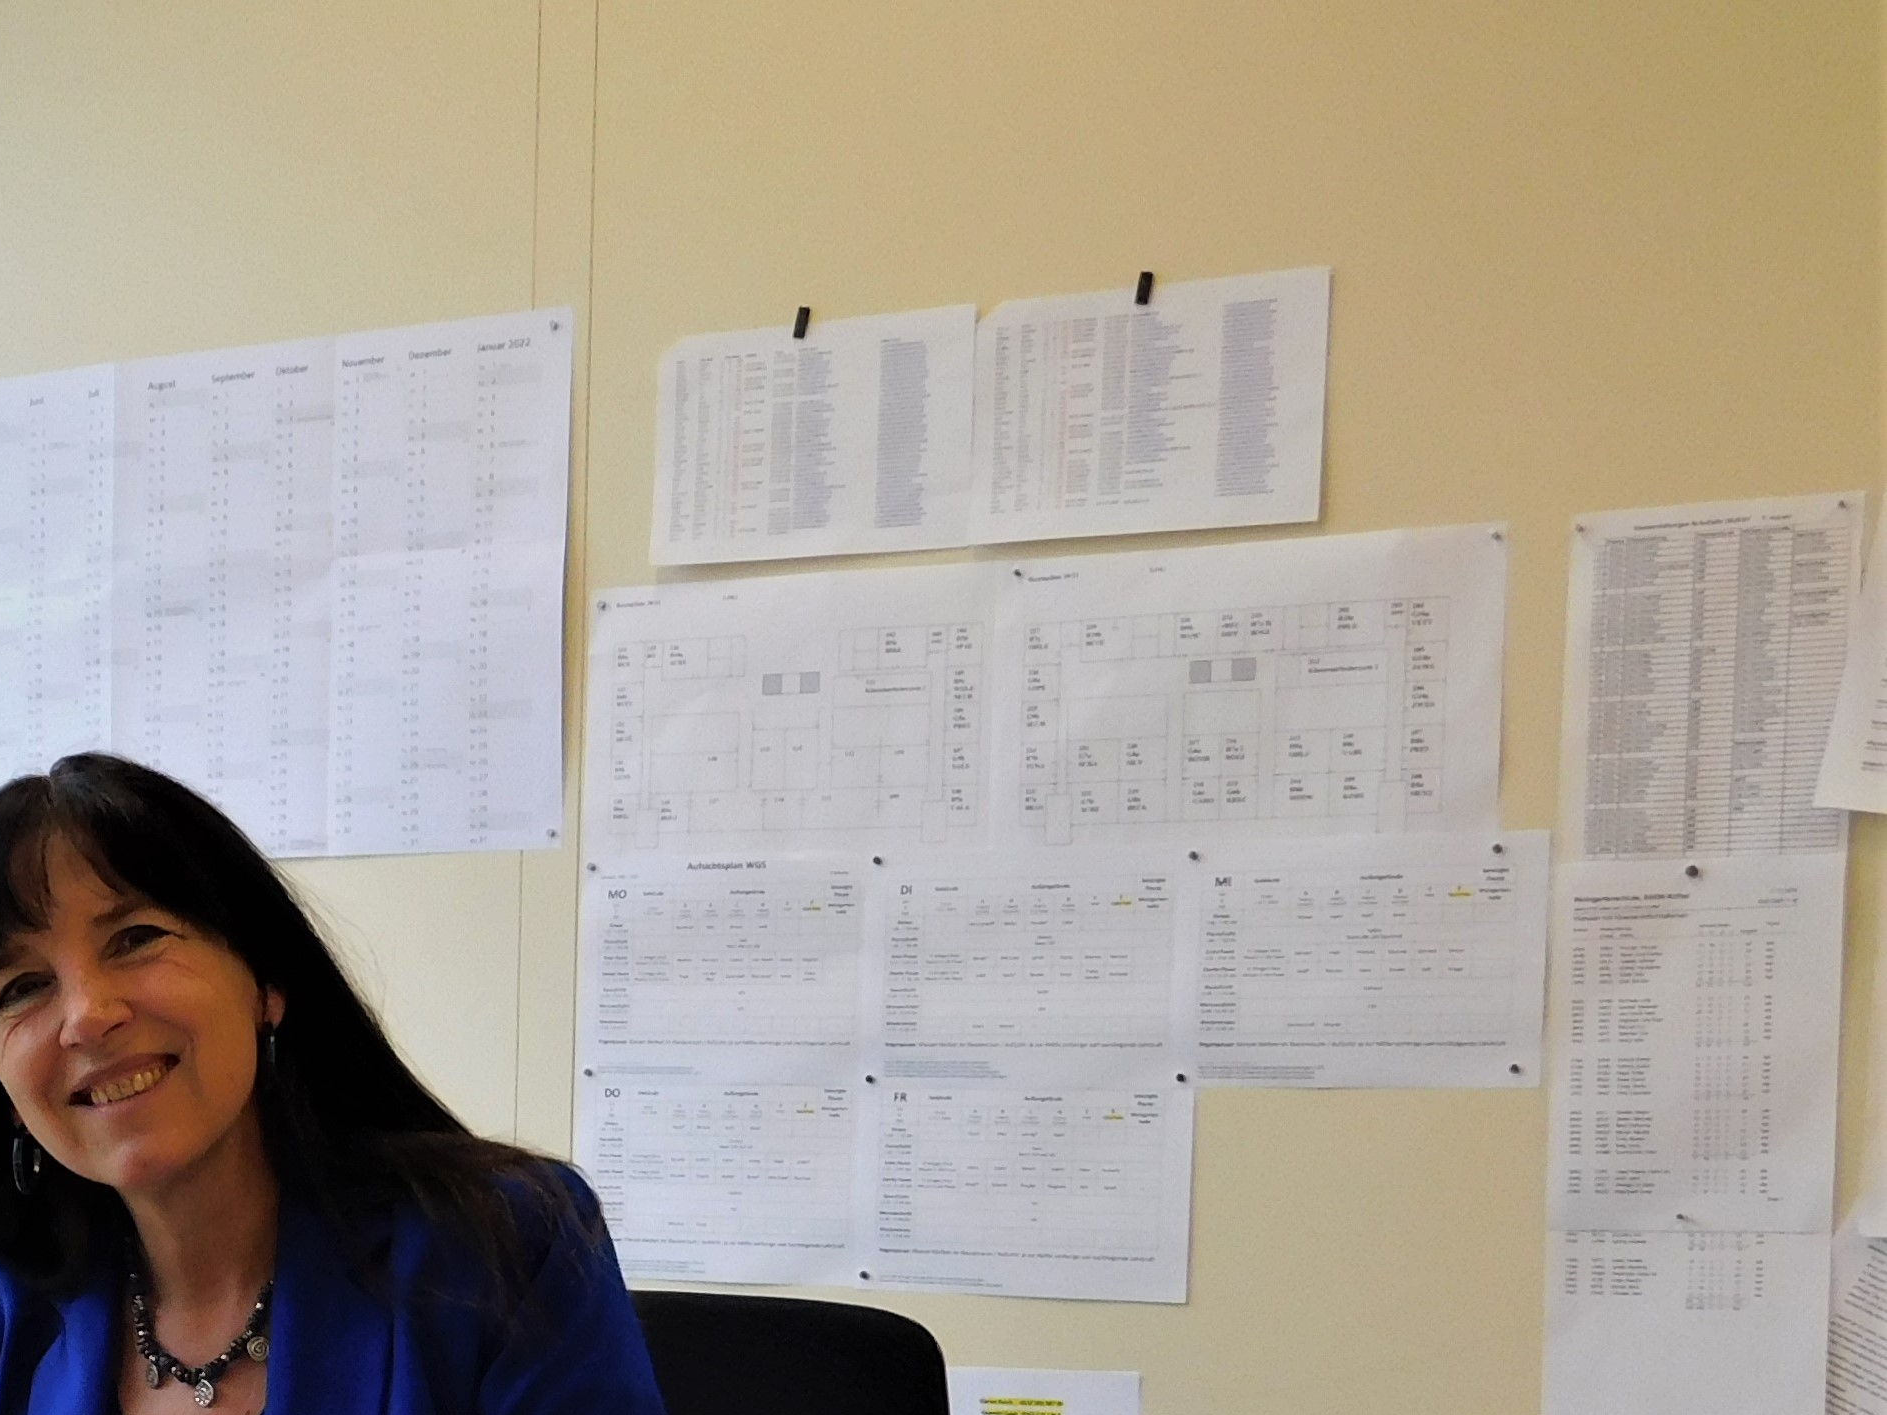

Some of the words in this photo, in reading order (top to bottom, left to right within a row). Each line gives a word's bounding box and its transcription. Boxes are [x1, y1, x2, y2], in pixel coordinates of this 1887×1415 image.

[477, 341, 506, 353] Januar
[507, 337, 532, 350] 2022
[409, 347, 453, 361] Dezember
[342, 355, 385, 368] November
[276, 364, 309, 377] Oktober
[212, 370, 256, 385] September
[147, 379, 176, 392] August
[88, 389, 100, 399] Juli
[29, 397, 45, 407] Juni
[746, 860, 767, 869] WGS
[1214, 876, 1232, 888] MI
[607, 890, 627, 900] MO
[900, 884, 913, 895] DI
[604, 1087, 621, 1099] DO
[893, 1092, 908, 1102] FR
